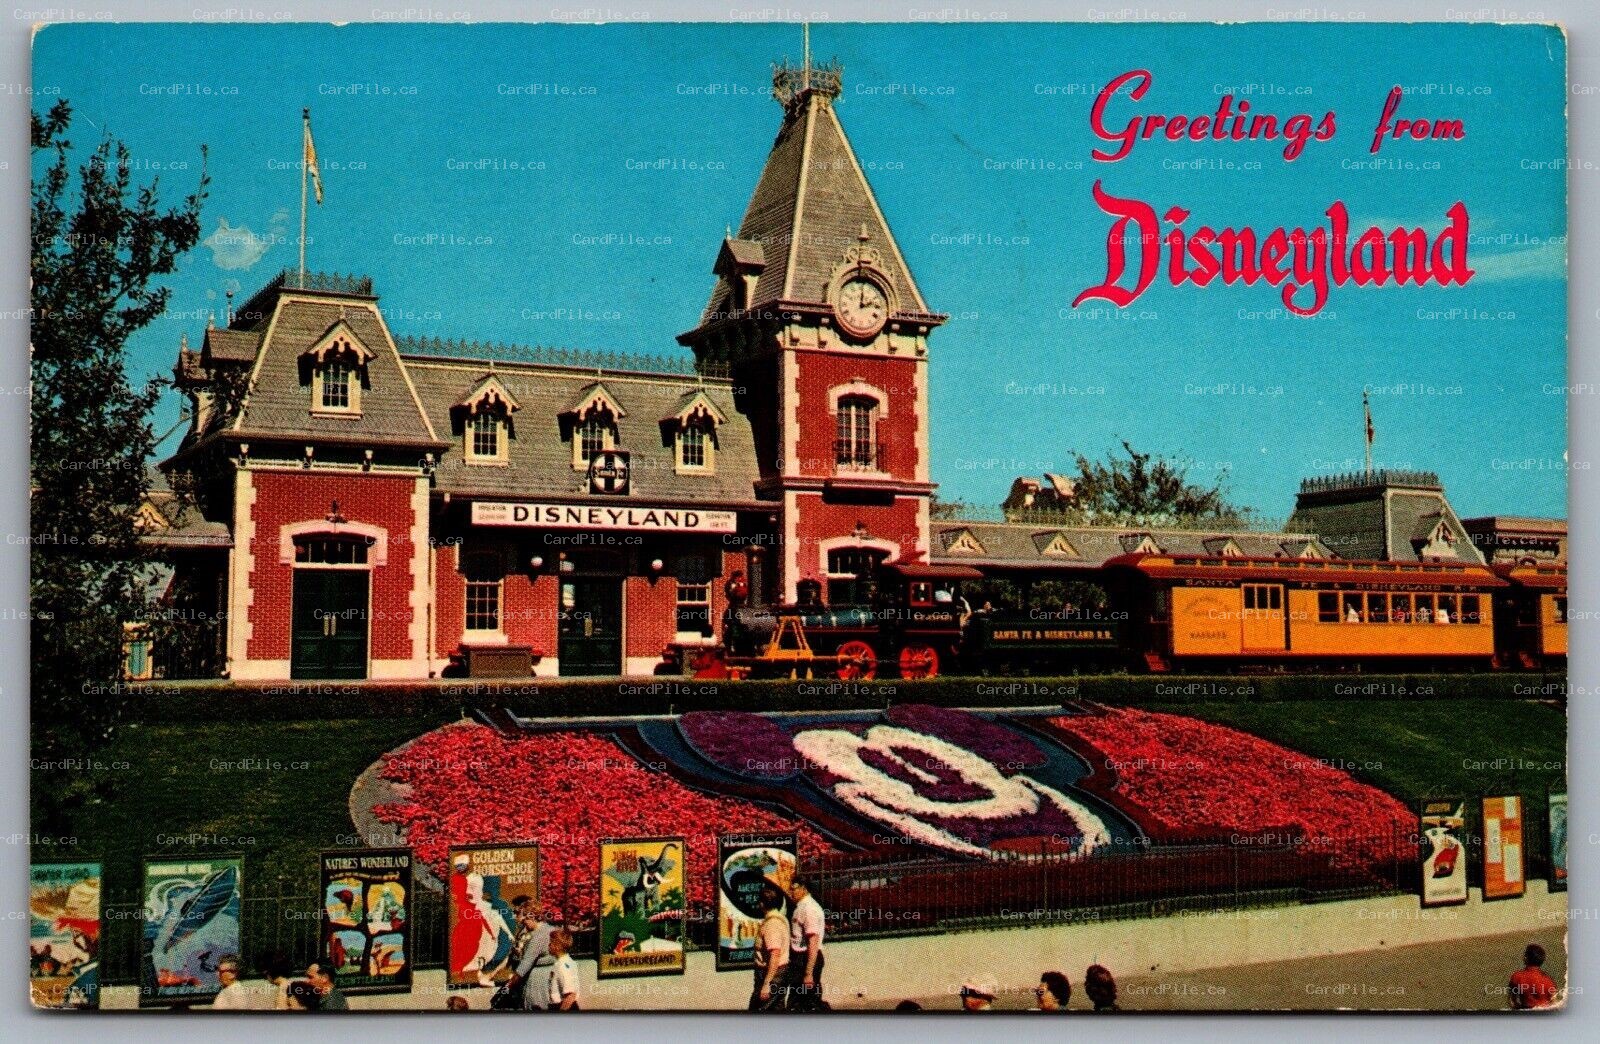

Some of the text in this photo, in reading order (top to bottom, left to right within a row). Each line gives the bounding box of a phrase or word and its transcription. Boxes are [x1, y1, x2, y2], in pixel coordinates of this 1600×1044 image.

[1090, 69, 1466, 162] Greetings from
[1072, 179, 1475, 317] Disneyland
[514, 506, 699, 528] DISNEYLAND
[1186, 579, 1235, 587] SANTA
[1356, 584, 1441, 592] DISNEYLAND
[993, 630, 1019, 639] SANTA
[1045, 630, 1094, 640] DISNEYLAND
[360, 855, 409, 868] WONDERLAND
[473, 849, 515, 863] GOLDEN
[473, 861, 535, 876] HORSESHOE
[608, 954, 675, 966] ADVENTURELAND
